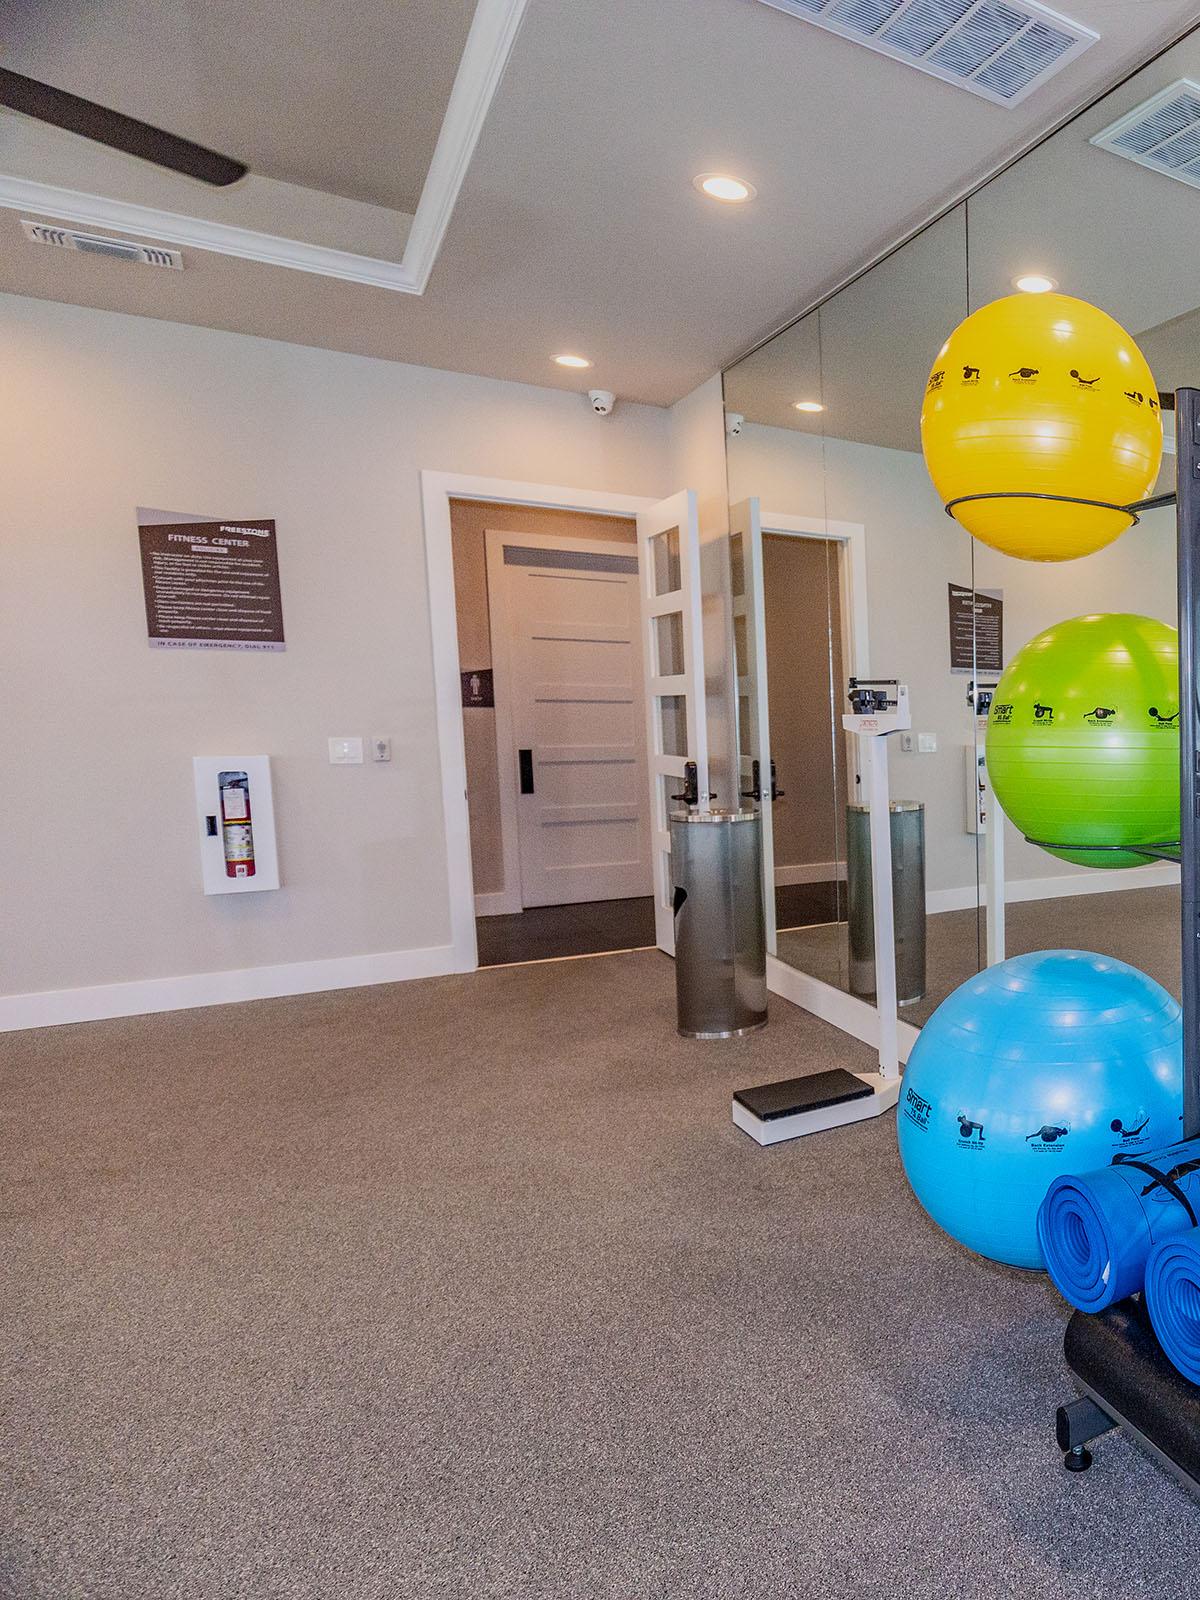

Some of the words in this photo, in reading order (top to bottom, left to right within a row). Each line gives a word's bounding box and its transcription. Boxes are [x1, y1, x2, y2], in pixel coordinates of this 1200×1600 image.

[168, 534, 208, 544] FITNESS
[212, 538, 250, 547] CENTER
[907, 1088, 932, 1118] Smart
